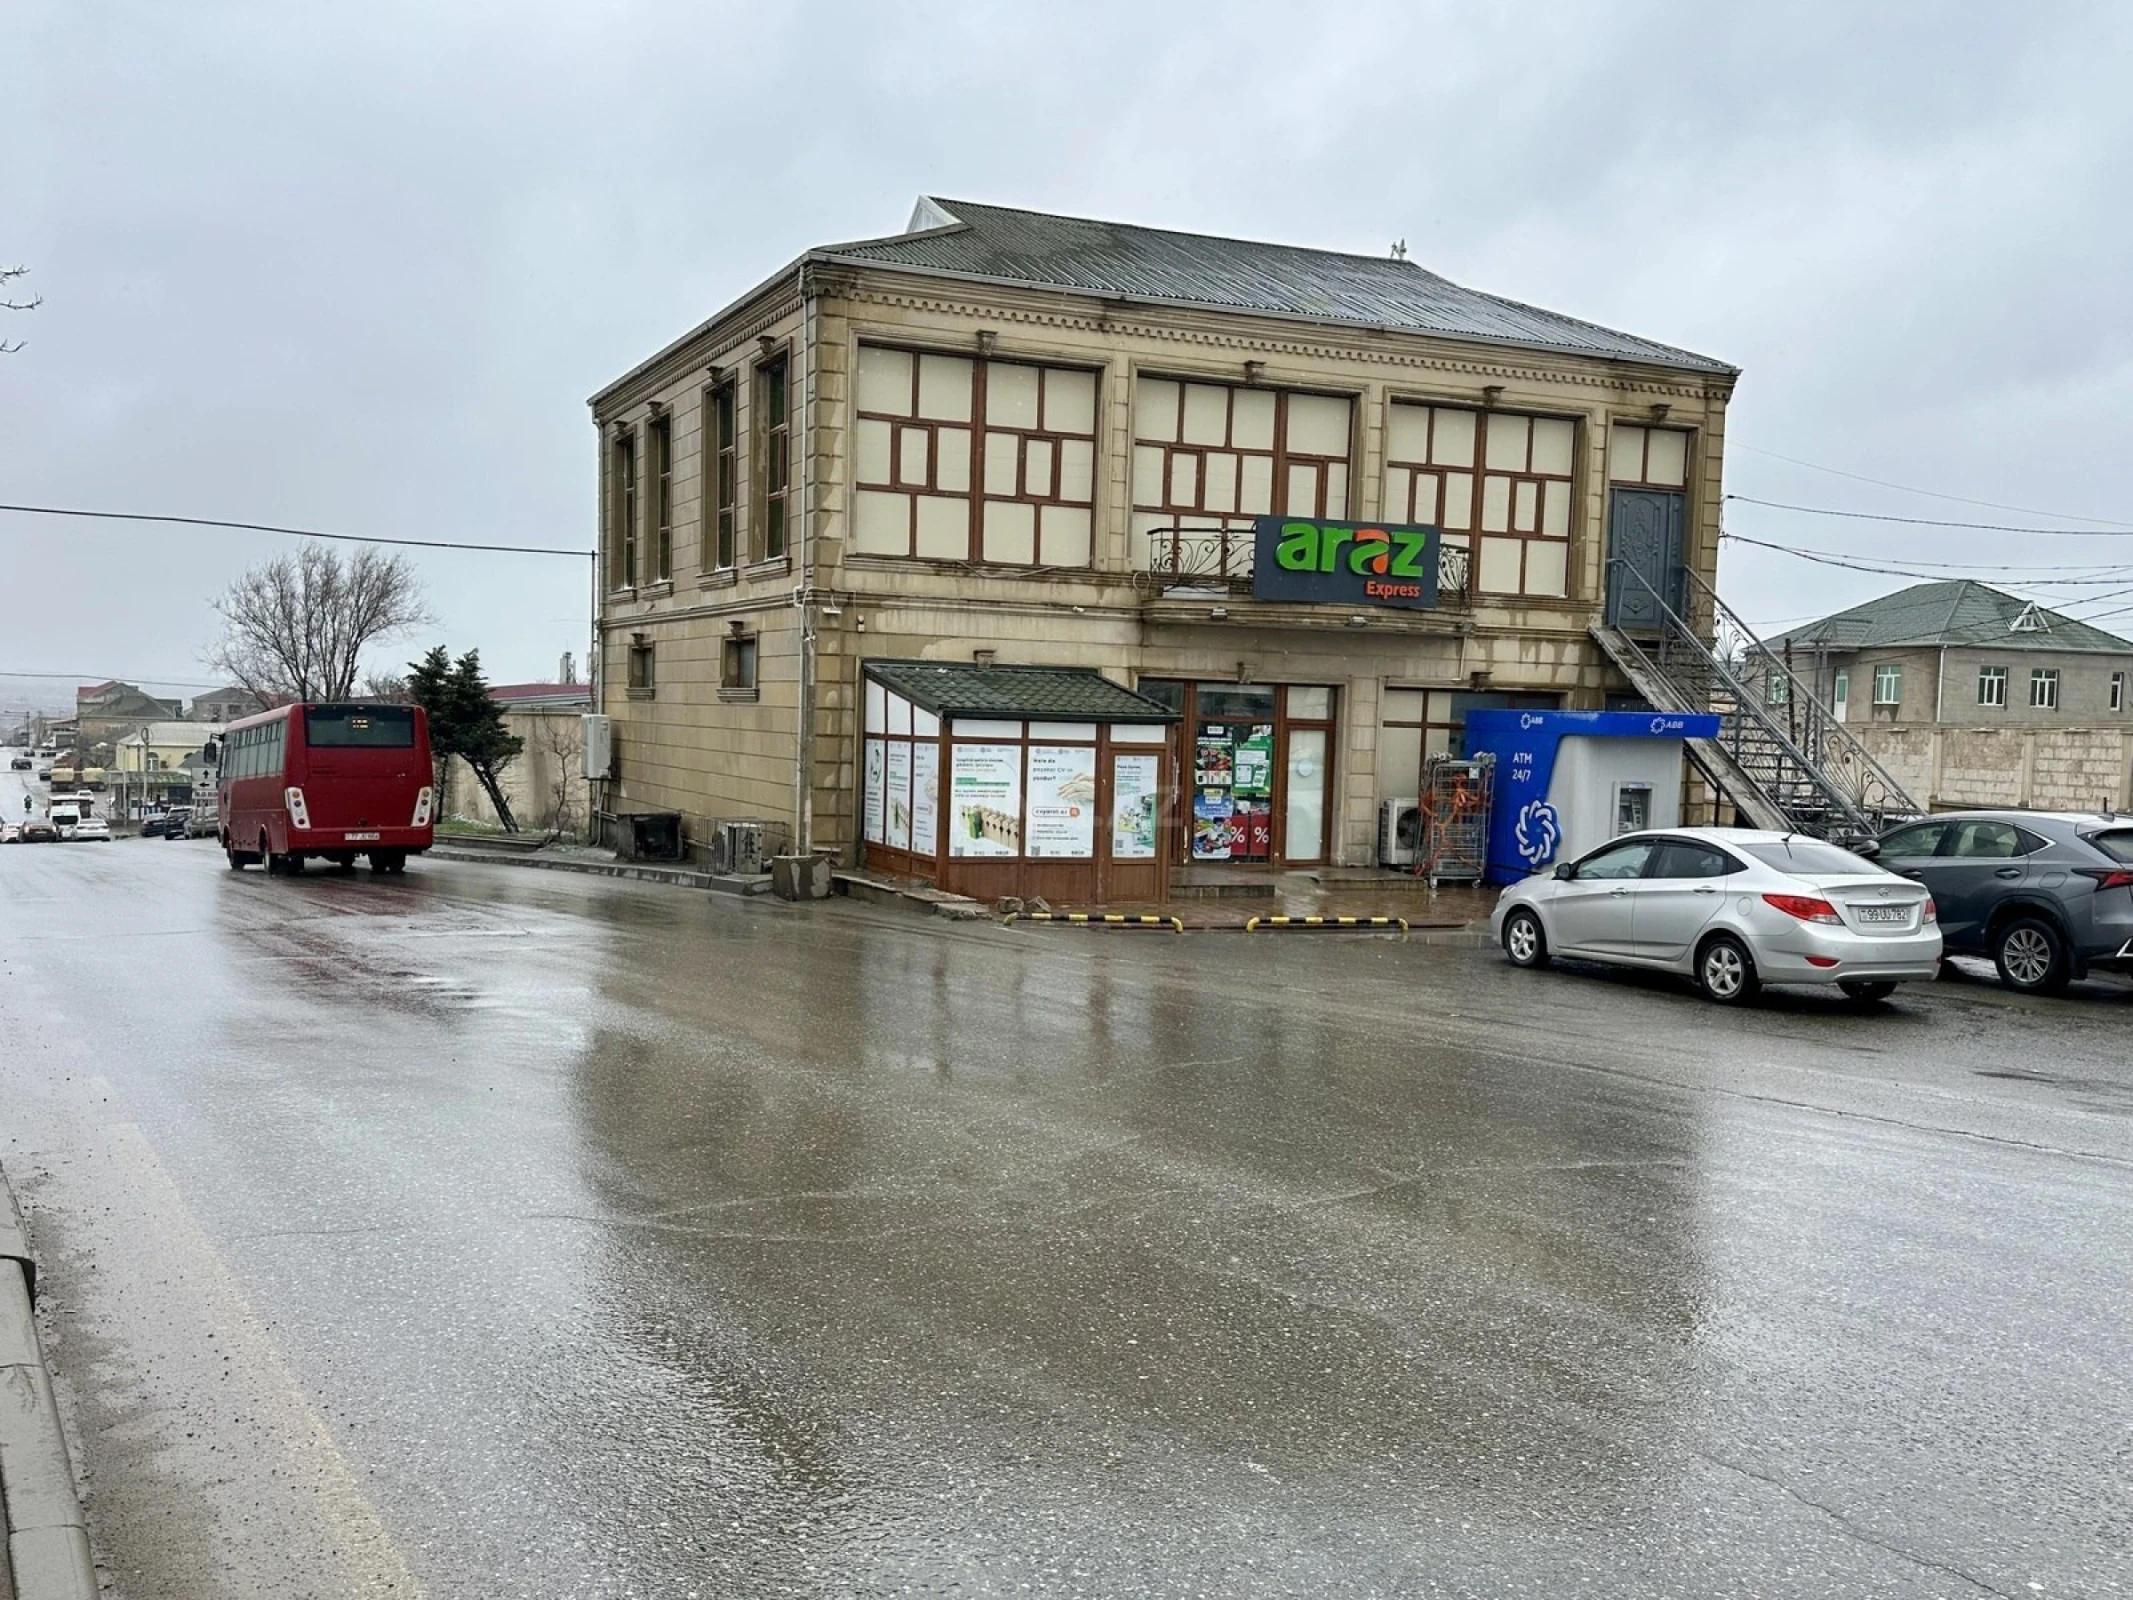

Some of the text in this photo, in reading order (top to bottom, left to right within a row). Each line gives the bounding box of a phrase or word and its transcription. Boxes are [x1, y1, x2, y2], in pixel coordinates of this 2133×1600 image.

[1275, 522, 1426, 578] araz
[1366, 581, 1421, 600] Express
[1664, 720, 1684, 729] ABB
[1512, 752, 1533, 765] ATM
[1512, 768, 1531, 782] 24/7
